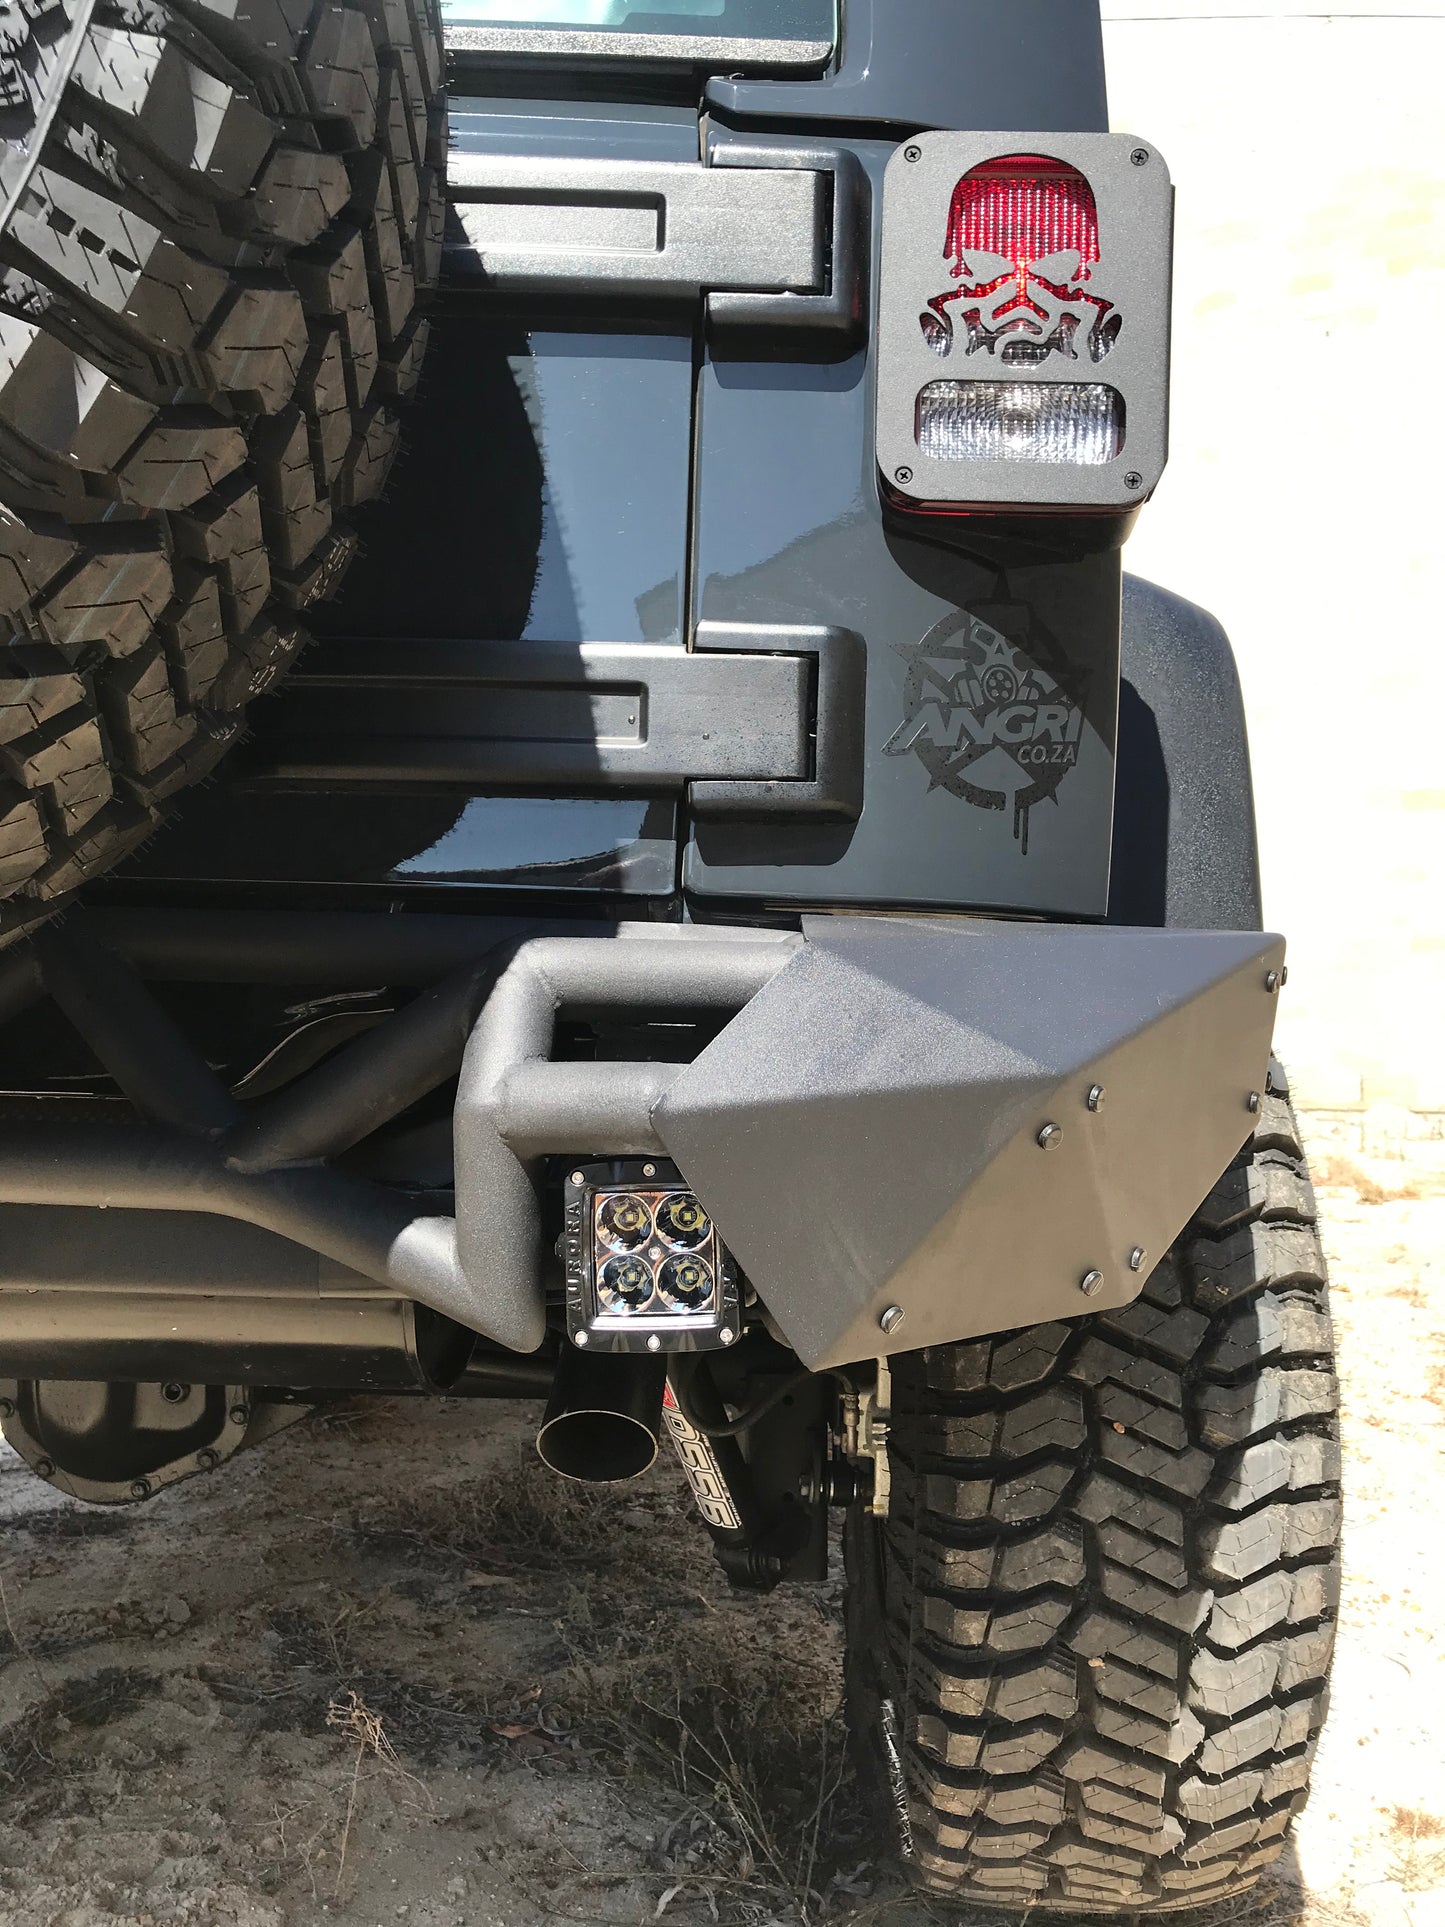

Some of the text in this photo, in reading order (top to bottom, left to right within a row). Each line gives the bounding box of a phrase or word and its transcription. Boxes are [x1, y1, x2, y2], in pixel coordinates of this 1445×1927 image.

[881, 702, 1082, 757] ANGRI
[1017, 744, 1077, 765] CO.ZA
[566, 1200, 582, 1312] AURORA
